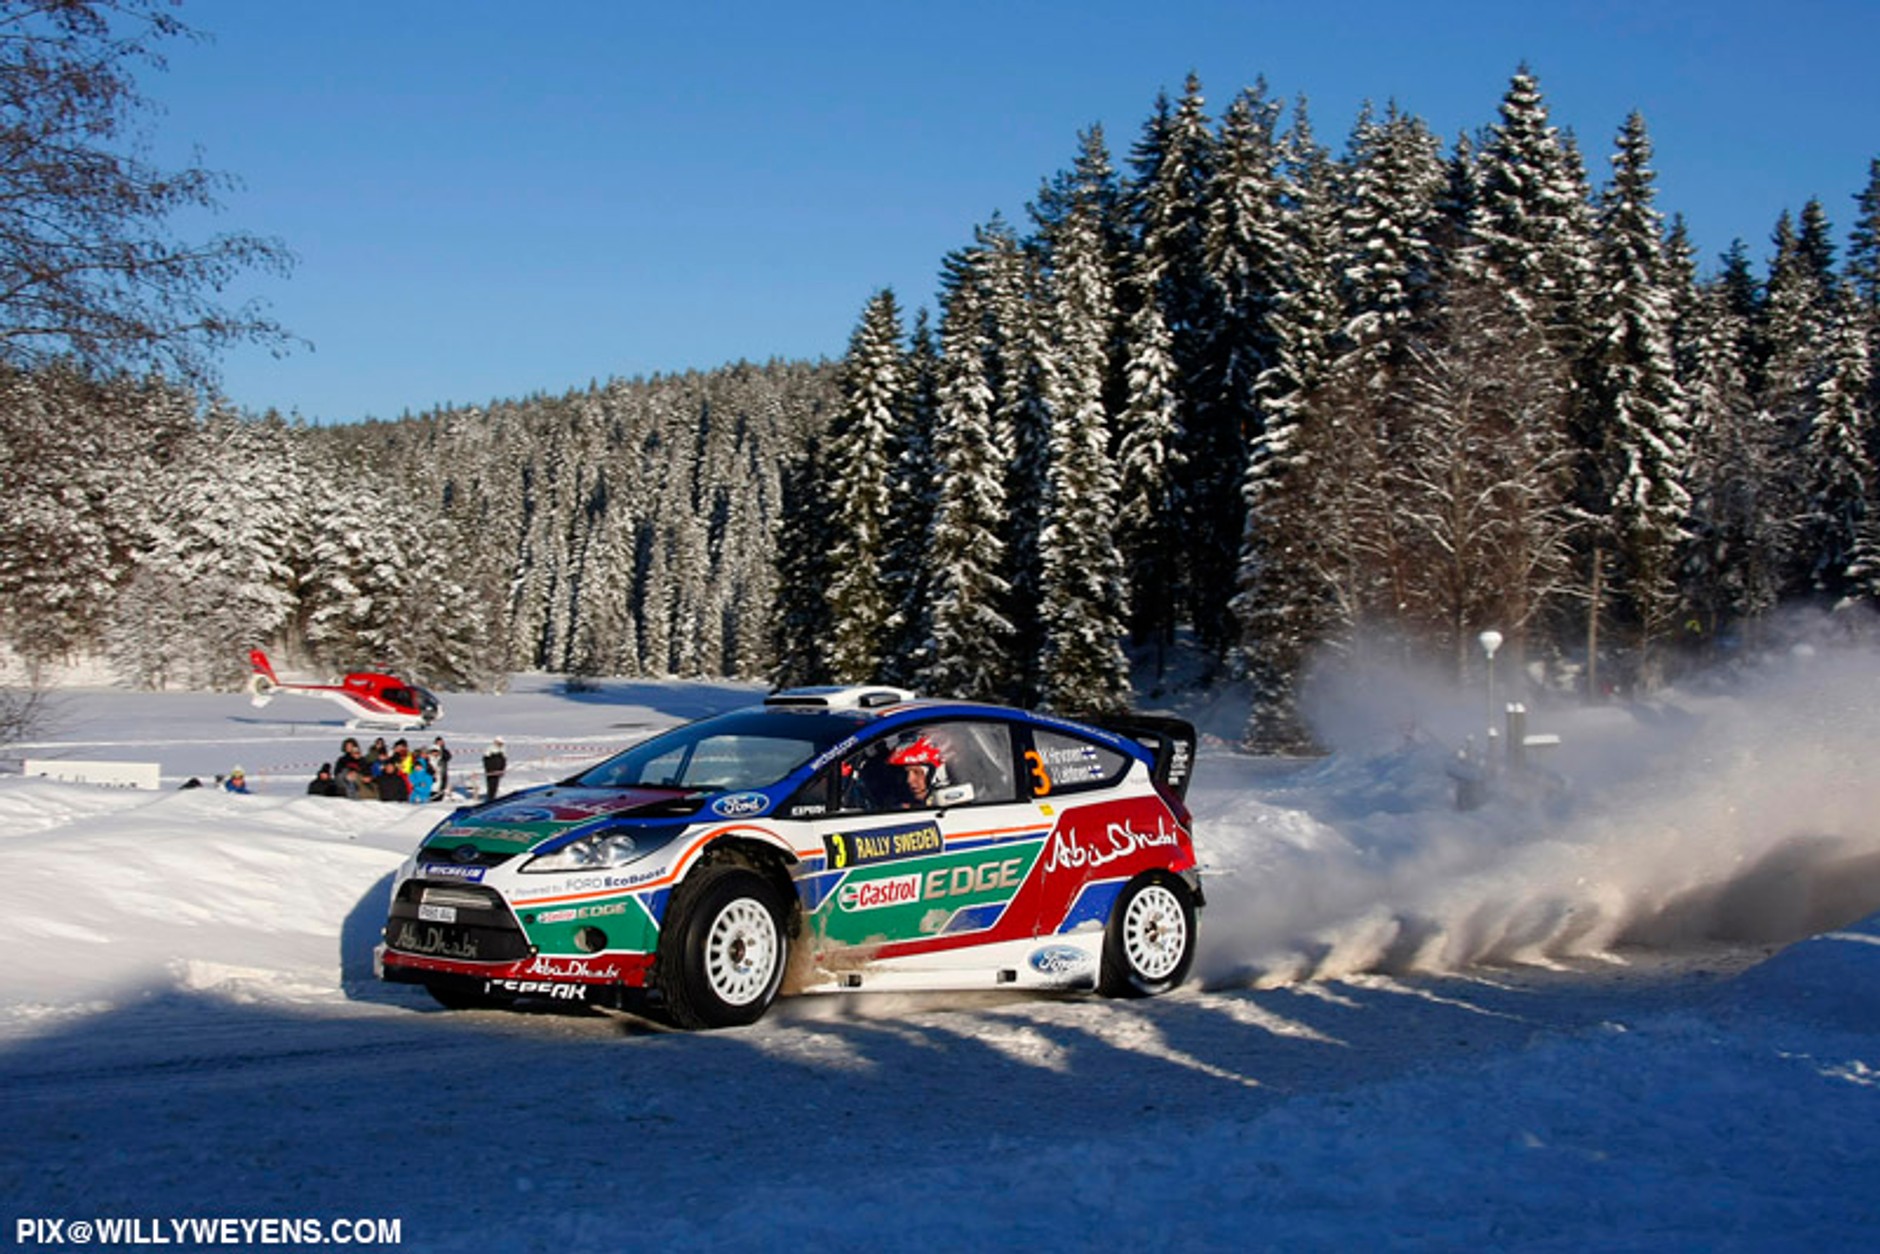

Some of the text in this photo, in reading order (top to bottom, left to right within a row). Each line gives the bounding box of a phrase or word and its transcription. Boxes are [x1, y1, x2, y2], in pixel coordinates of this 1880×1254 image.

[1023, 749, 1052, 796] 3
[723, 798, 761, 814] Ford
[832, 834, 848, 868] 3
[855, 827, 940, 859] RALLY SWEDEN
[1044, 815, 1178, 872] Abu Dhabi
[566, 877, 602, 891] FORD
[603, 866, 667, 887] EcoBoost
[859, 857, 1023, 907] Castrol EDGE
[577, 902, 628, 918] EDGE
[525, 956, 562, 975] Abu
